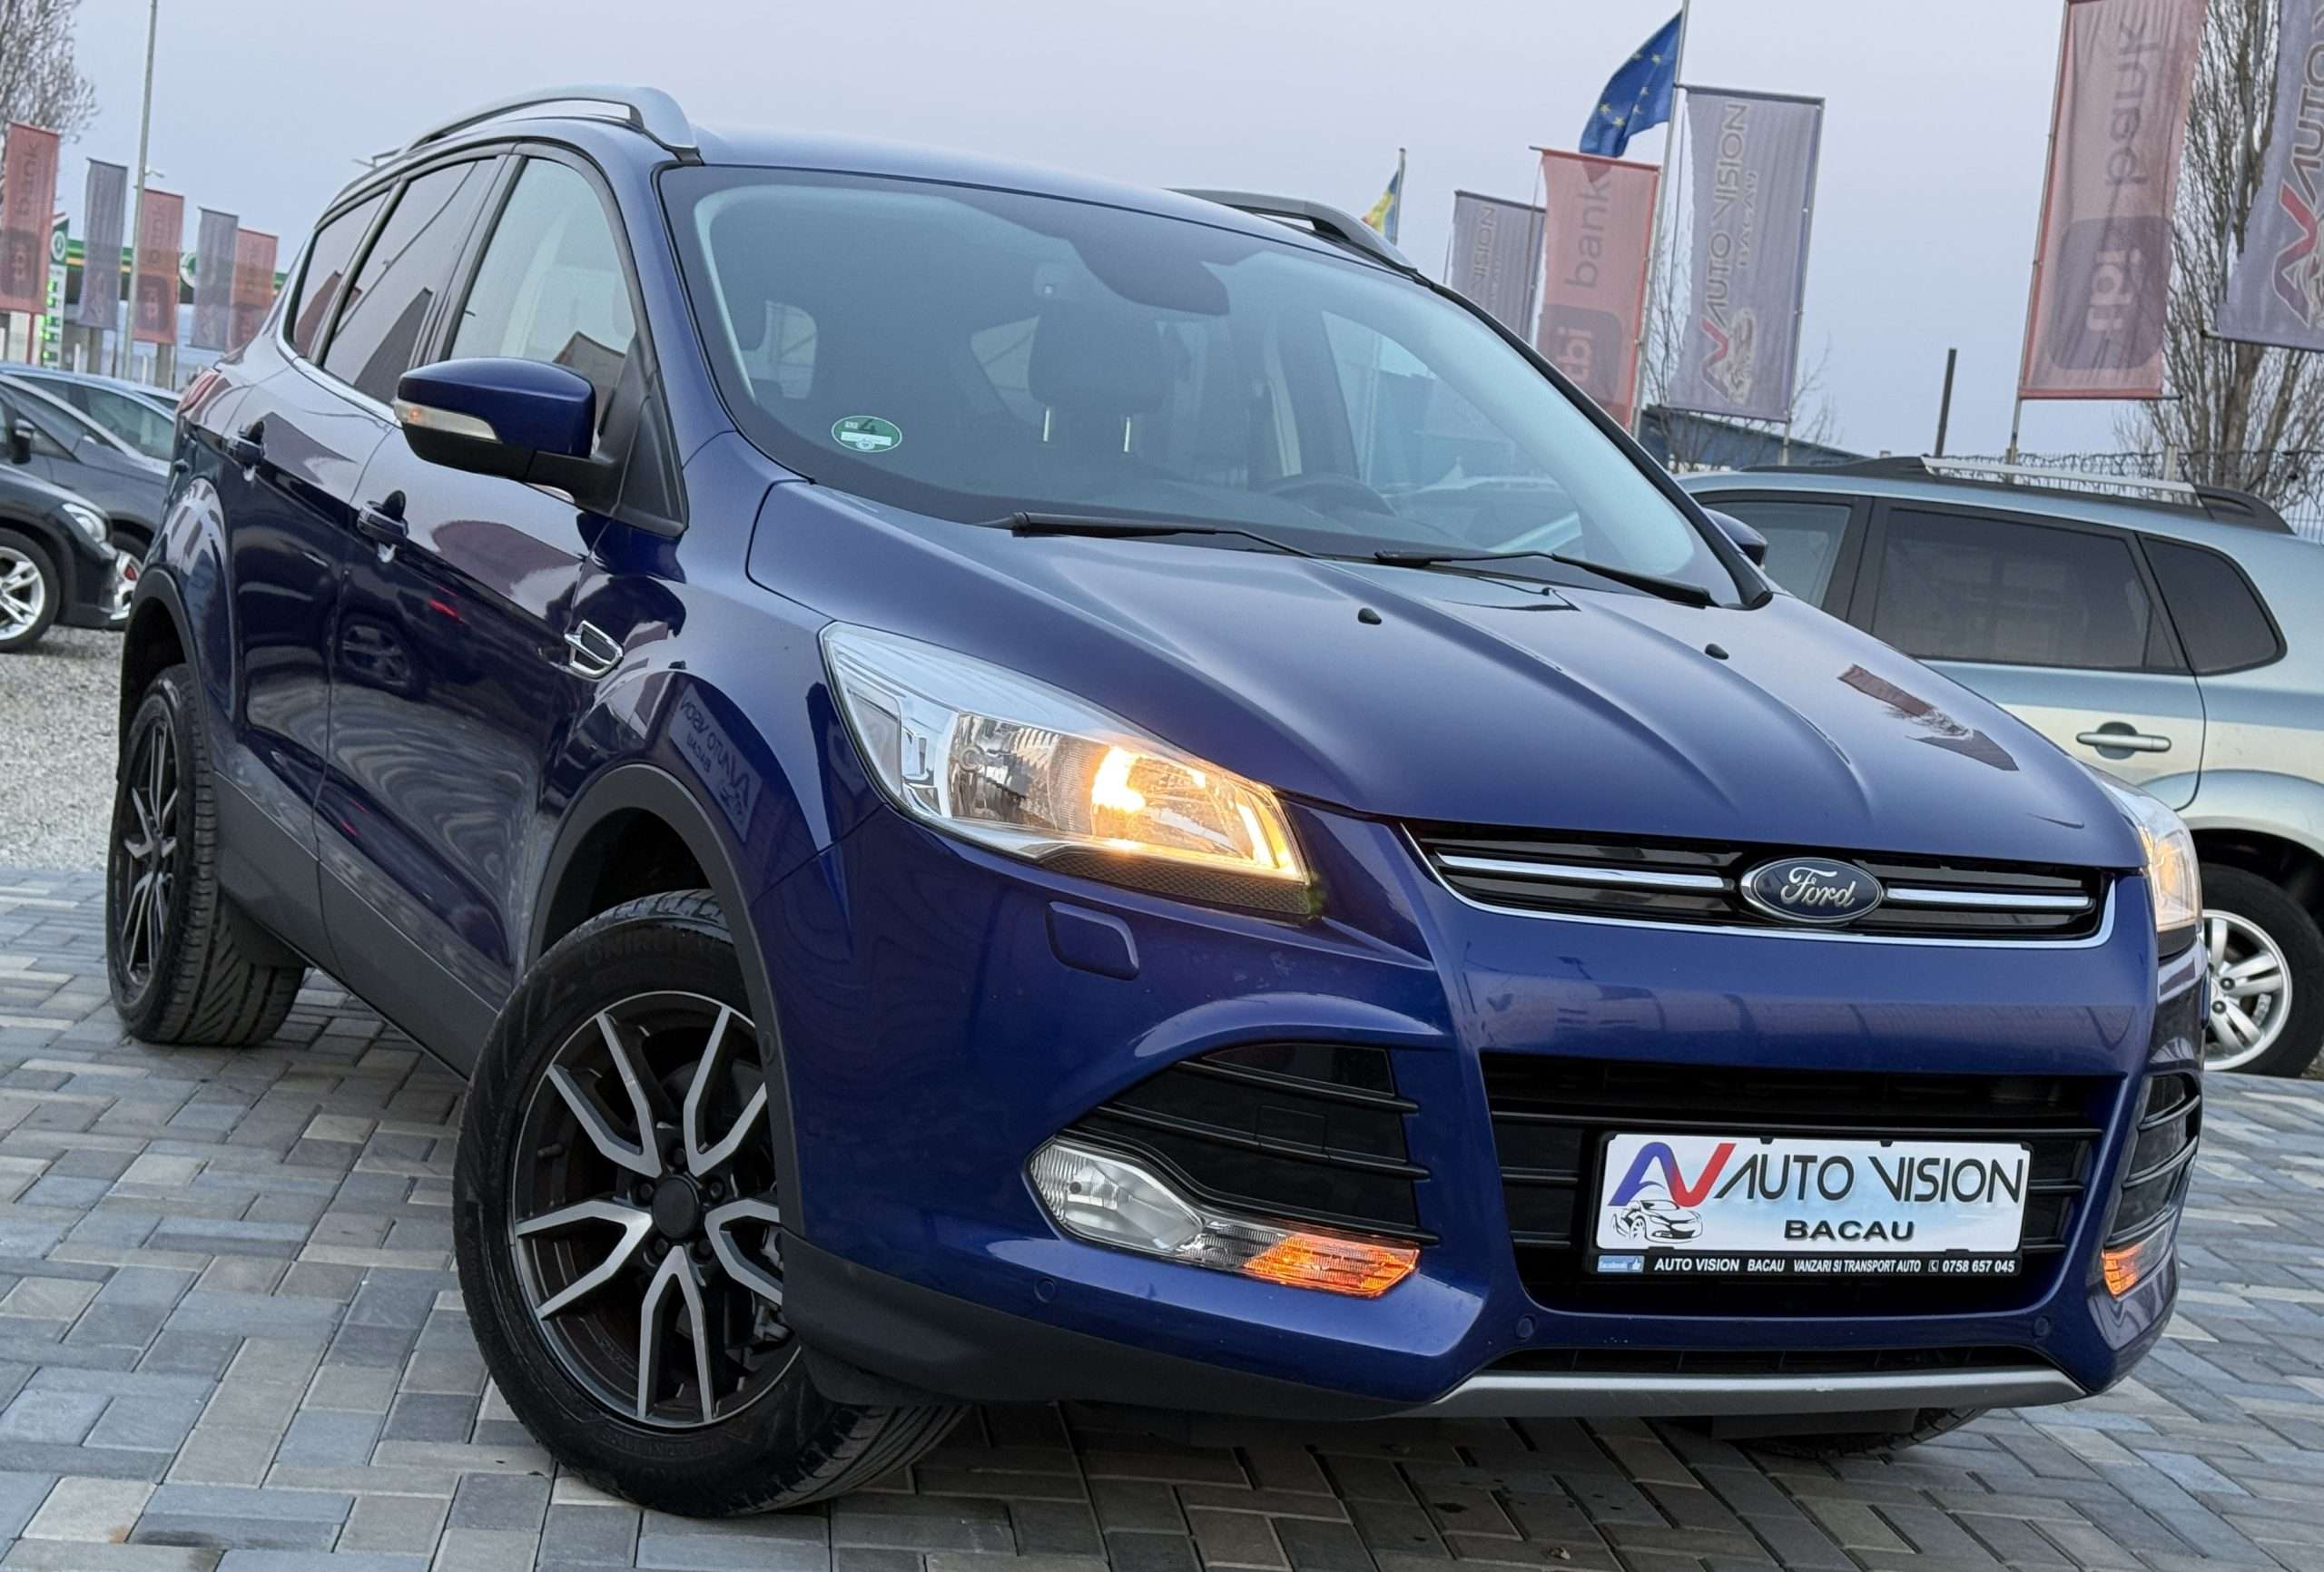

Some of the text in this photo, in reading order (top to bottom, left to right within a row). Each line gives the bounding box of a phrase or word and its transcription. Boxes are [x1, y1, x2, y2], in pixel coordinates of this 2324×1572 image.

[1713, 103, 1750, 221] VISION
[1565, 181, 1610, 290] bank
[1706, 231, 1731, 327] AUTO
[1780, 867, 1856, 907] Ford
[1714, 1154, 1855, 1201] AUTO
[1869, 1155, 2024, 1204] VISION
[1783, 1219, 1915, 1243] BACAU
[1654, 1258, 1692, 1272] AUTO
[1696, 1258, 1740, 1272] VISION
[1748, 1259, 1786, 1272] BACAU
[1793, 1259, 1832, 1272] VANZARI
[1833, 1259, 1843, 1272] SI
[1844, 1259, 1896, 1272] TRANSPORT
[1896, 1259, 1922, 1272] AUTO
[1942, 1259, 1970, 1272] 0758
[1972, 1259, 1993, 1272] 657
[1994, 1259, 2015, 1272] 045
